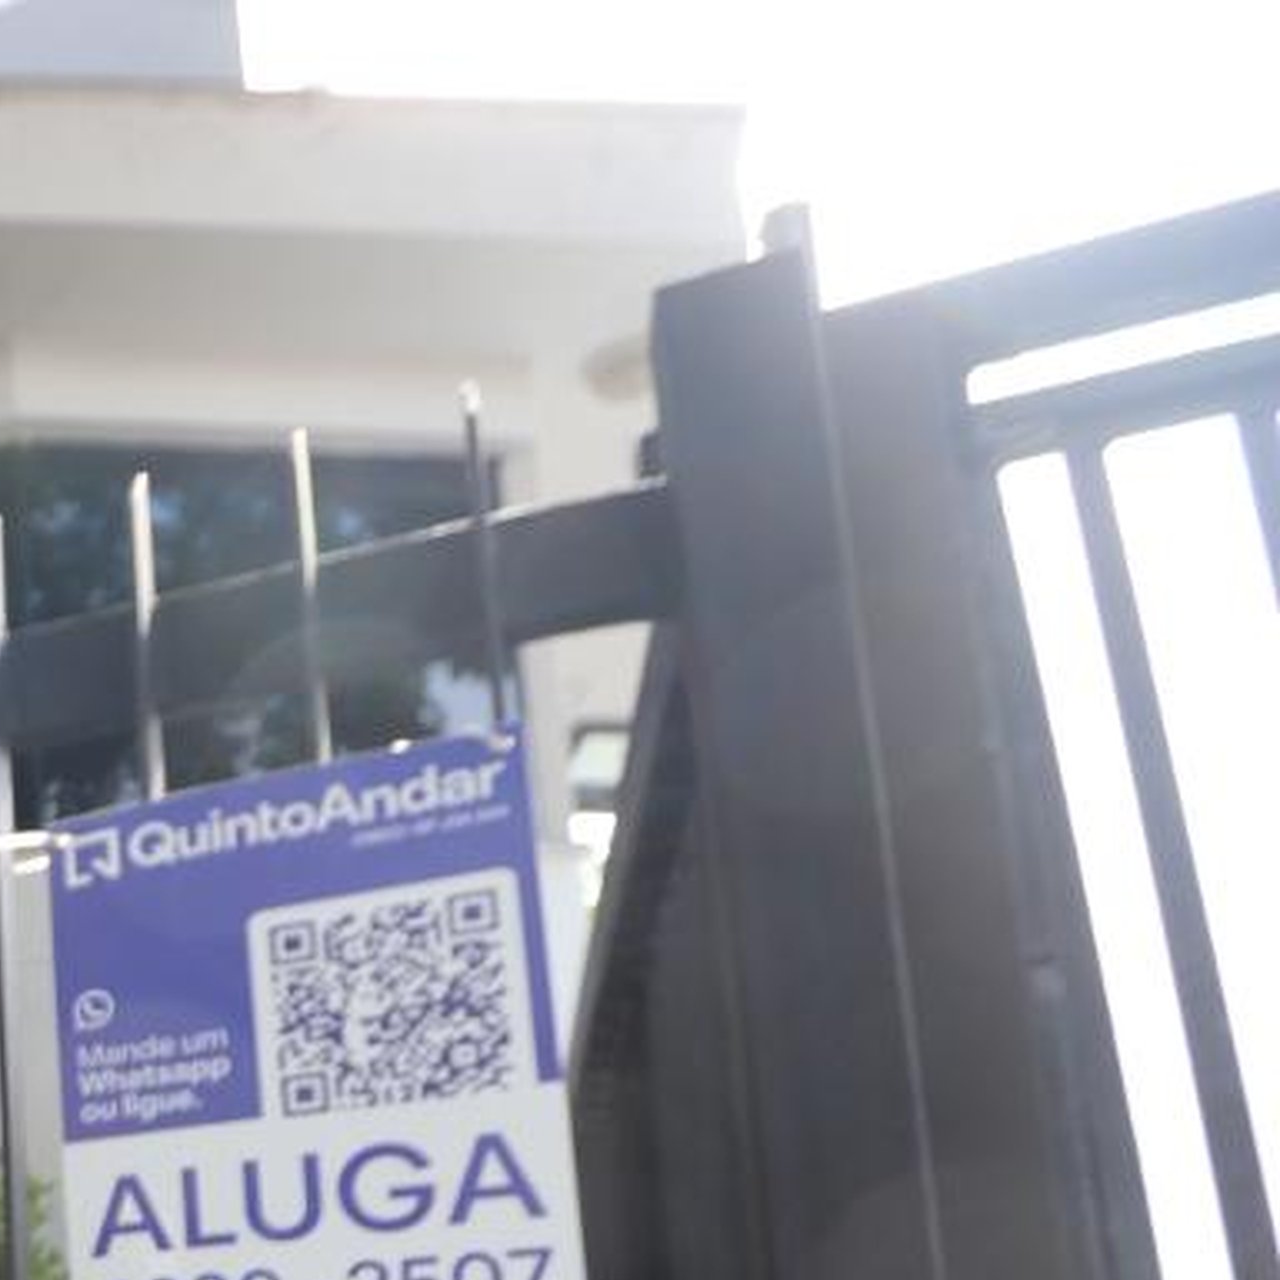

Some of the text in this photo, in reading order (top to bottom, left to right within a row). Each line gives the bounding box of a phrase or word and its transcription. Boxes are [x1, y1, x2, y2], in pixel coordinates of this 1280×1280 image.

[128, 760, 507, 868] QuintoAndar
[77, 1028, 230, 1069] Mande um
[79, 1055, 232, 1097] Whatsapp
[79, 1100, 118, 1124] ou
[91, 1132, 548, 1258] ALUGA
